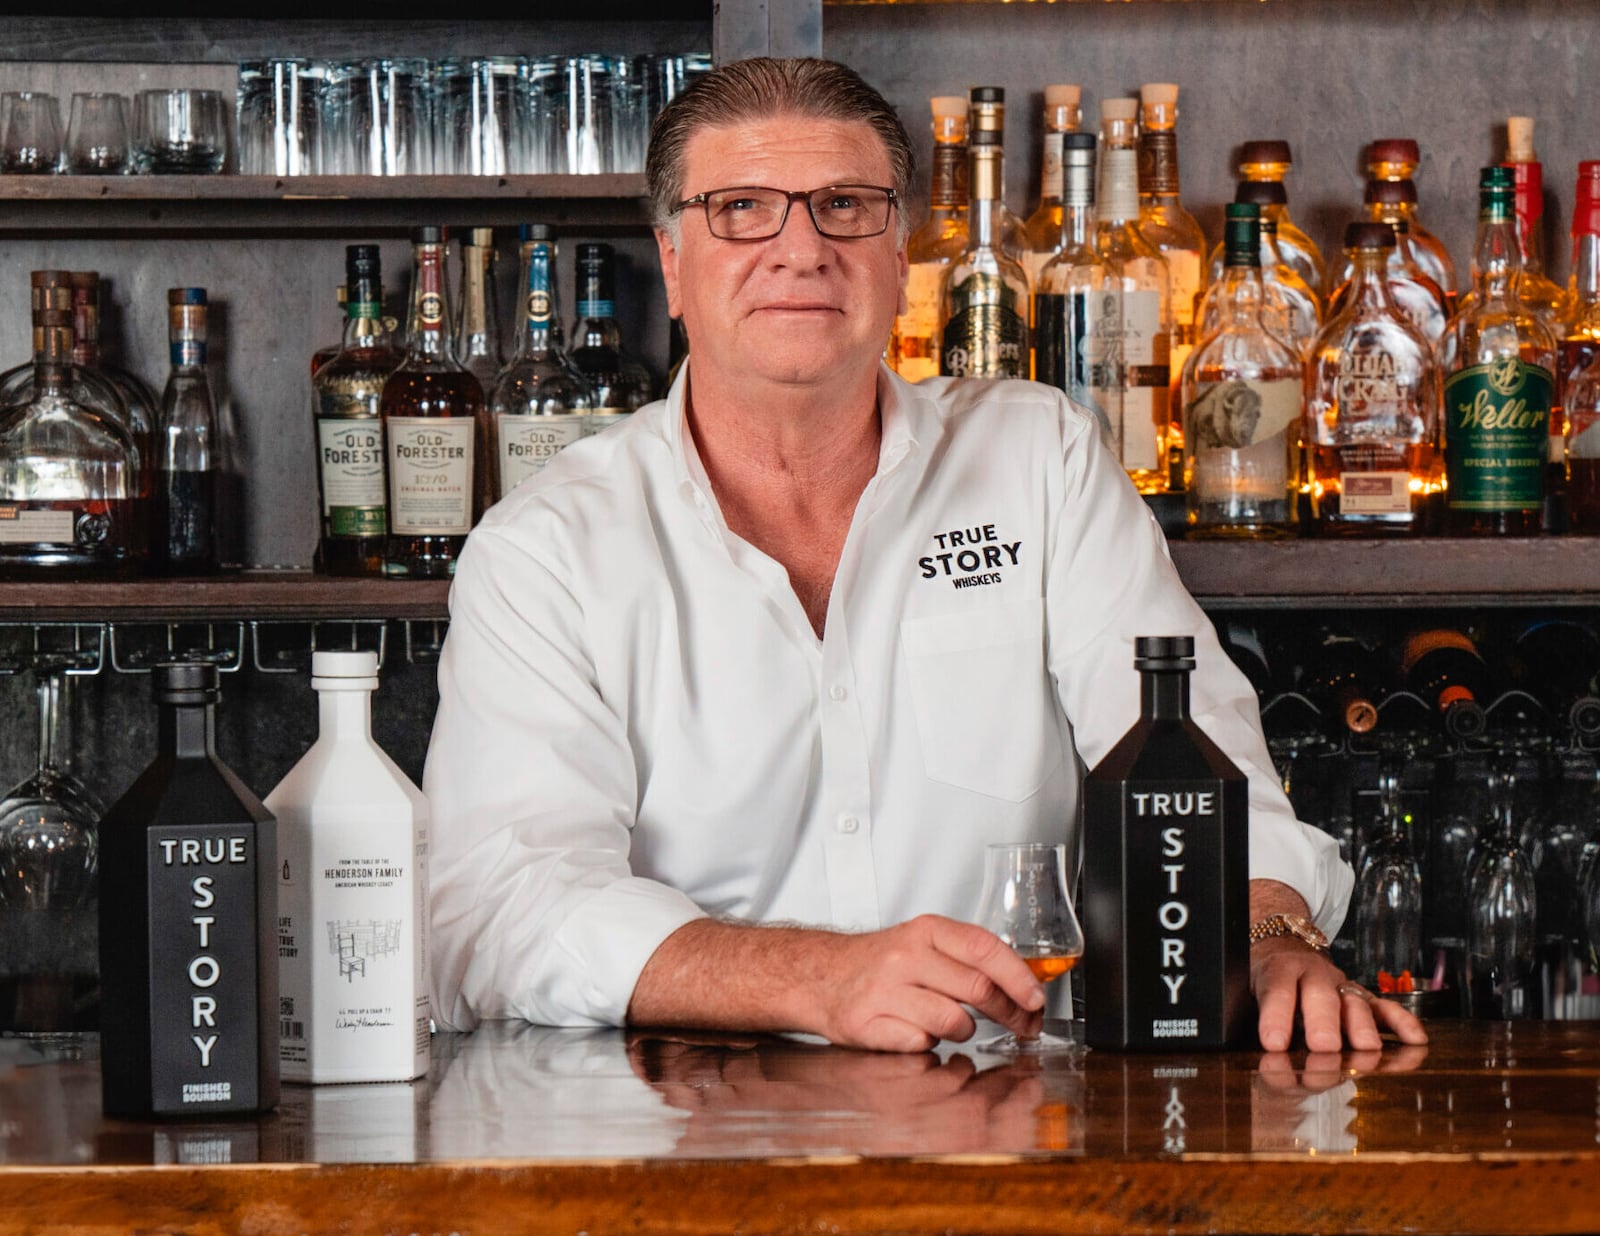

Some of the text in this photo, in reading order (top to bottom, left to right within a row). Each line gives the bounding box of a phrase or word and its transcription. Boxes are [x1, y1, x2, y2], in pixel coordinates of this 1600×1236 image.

[1458, 389, 1545, 430] Weller
[345, 434, 375, 448] OLD
[416, 434, 443, 446] OLD
[529, 432, 556, 443] OLD
[396, 444, 465, 459] FORESTER
[1463, 458, 1503, 467] SPECIAL
[933, 524, 998, 549] TRUE
[918, 541, 1022, 579] STORY
[952, 572, 1002, 590] WHISKEYS
[1132, 792, 1215, 816] TRUE
[159, 838, 246, 864] TRUE
[324, 868, 403, 879] HENDERSON FAMILY
[1159, 827, 1188, 1004] STORY
[188, 876, 221, 1067] STORY
[1153, 1019, 1198, 1029] FINISHED
[1153, 1028, 1198, 1038] BOURBON
[182, 1082, 231, 1093] FINISHED
[182, 1091, 231, 1103] BOURBON
